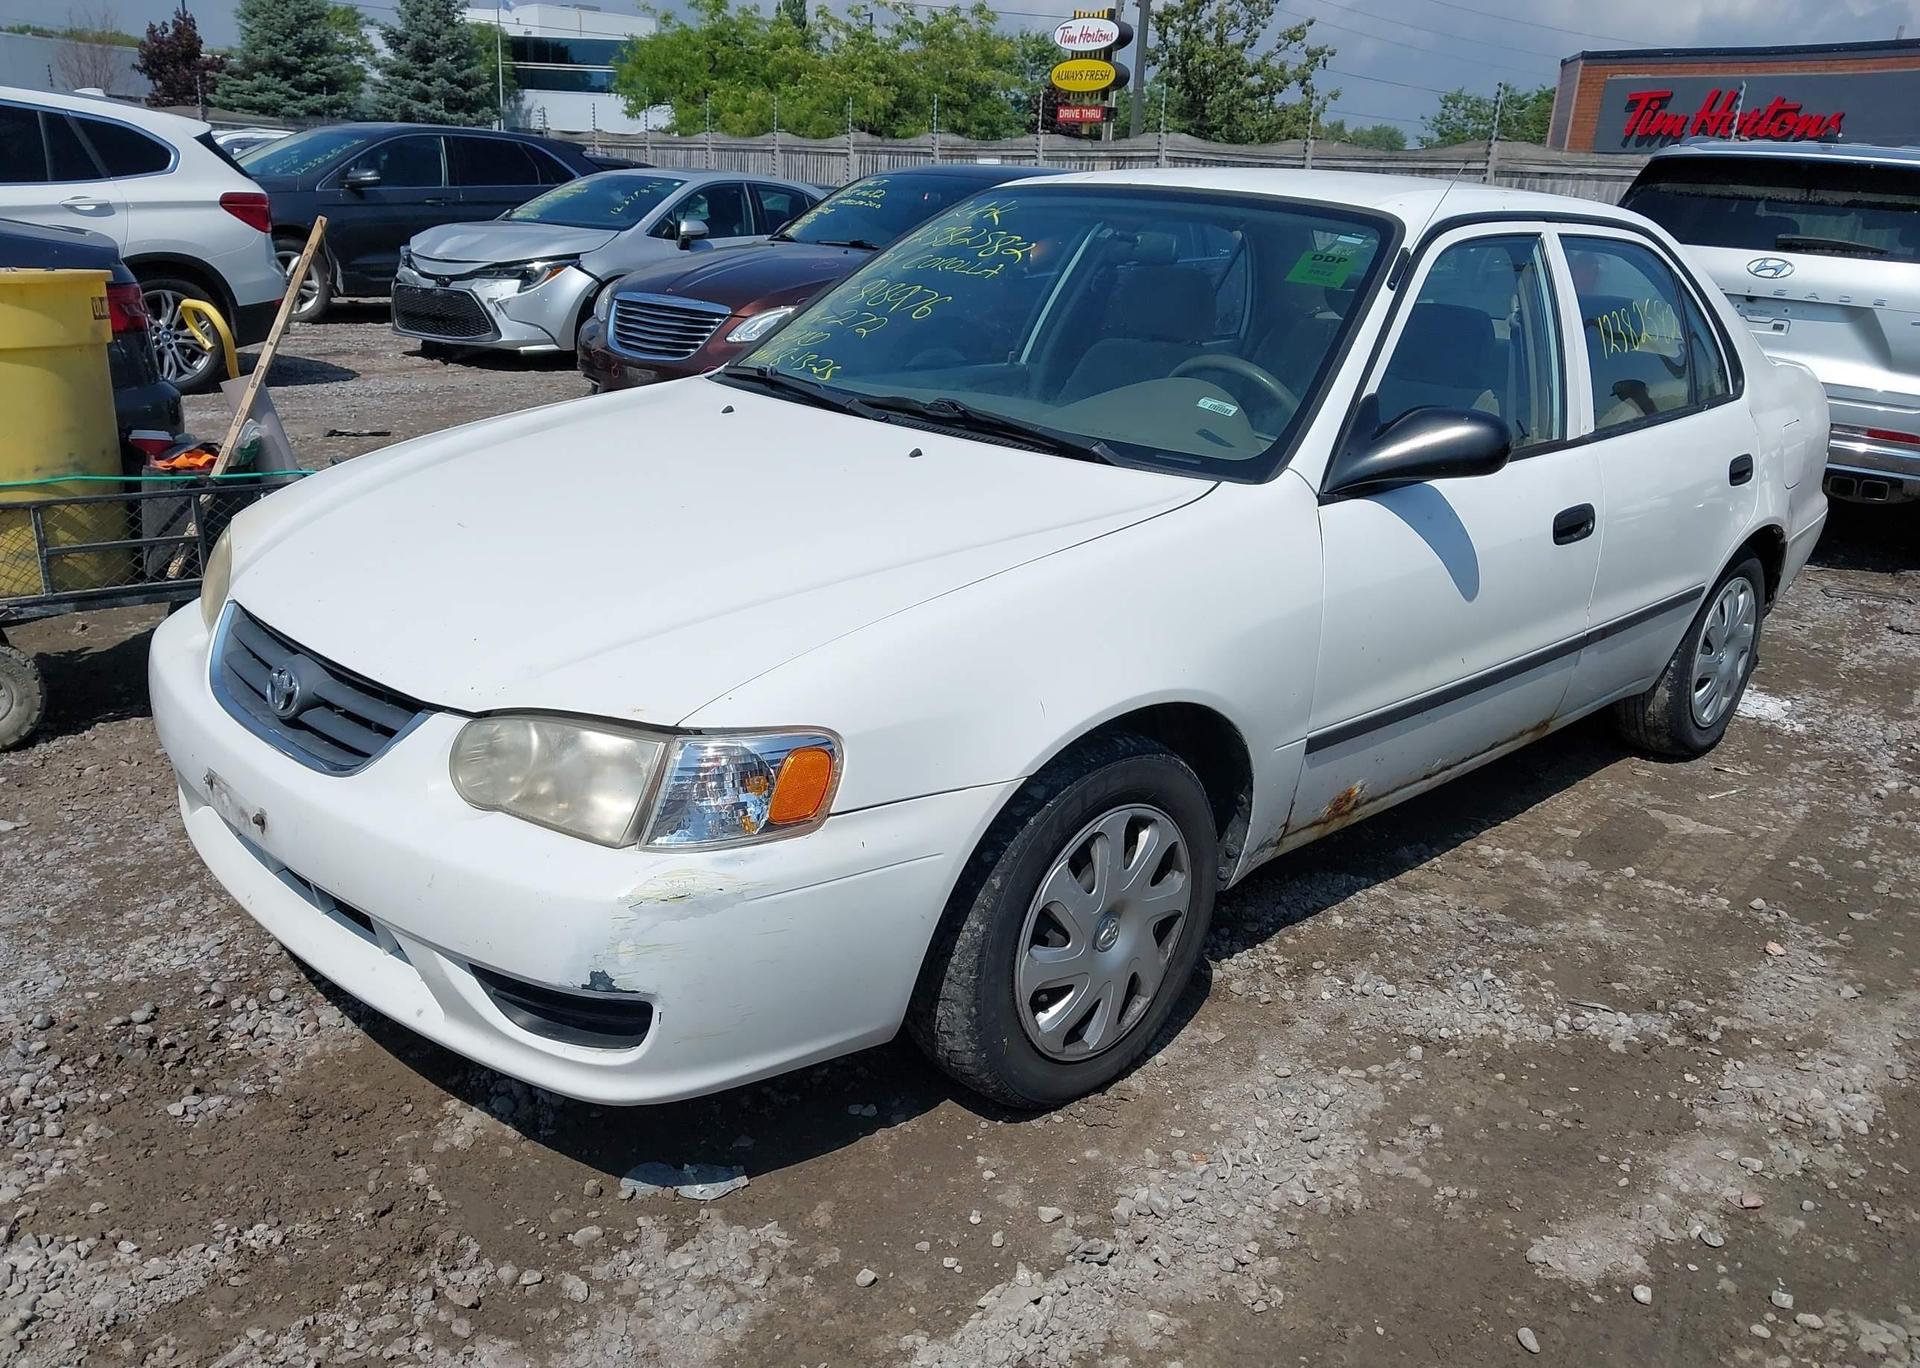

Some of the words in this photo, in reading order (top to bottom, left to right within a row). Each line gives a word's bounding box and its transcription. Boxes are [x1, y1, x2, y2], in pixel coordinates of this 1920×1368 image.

[1059, 25, 1077, 45] Tim
[1078, 24, 1114, 44] Hortons
[1055, 69, 1084, 81] ALWAYS
[1083, 69, 1111, 81] FRESH
[1058, 108, 1081, 119] DRIVE
[1081, 108, 1101, 119] THRU
[1623, 90, 1687, 137] Tim
[1690, 88, 1845, 138] Hortons
